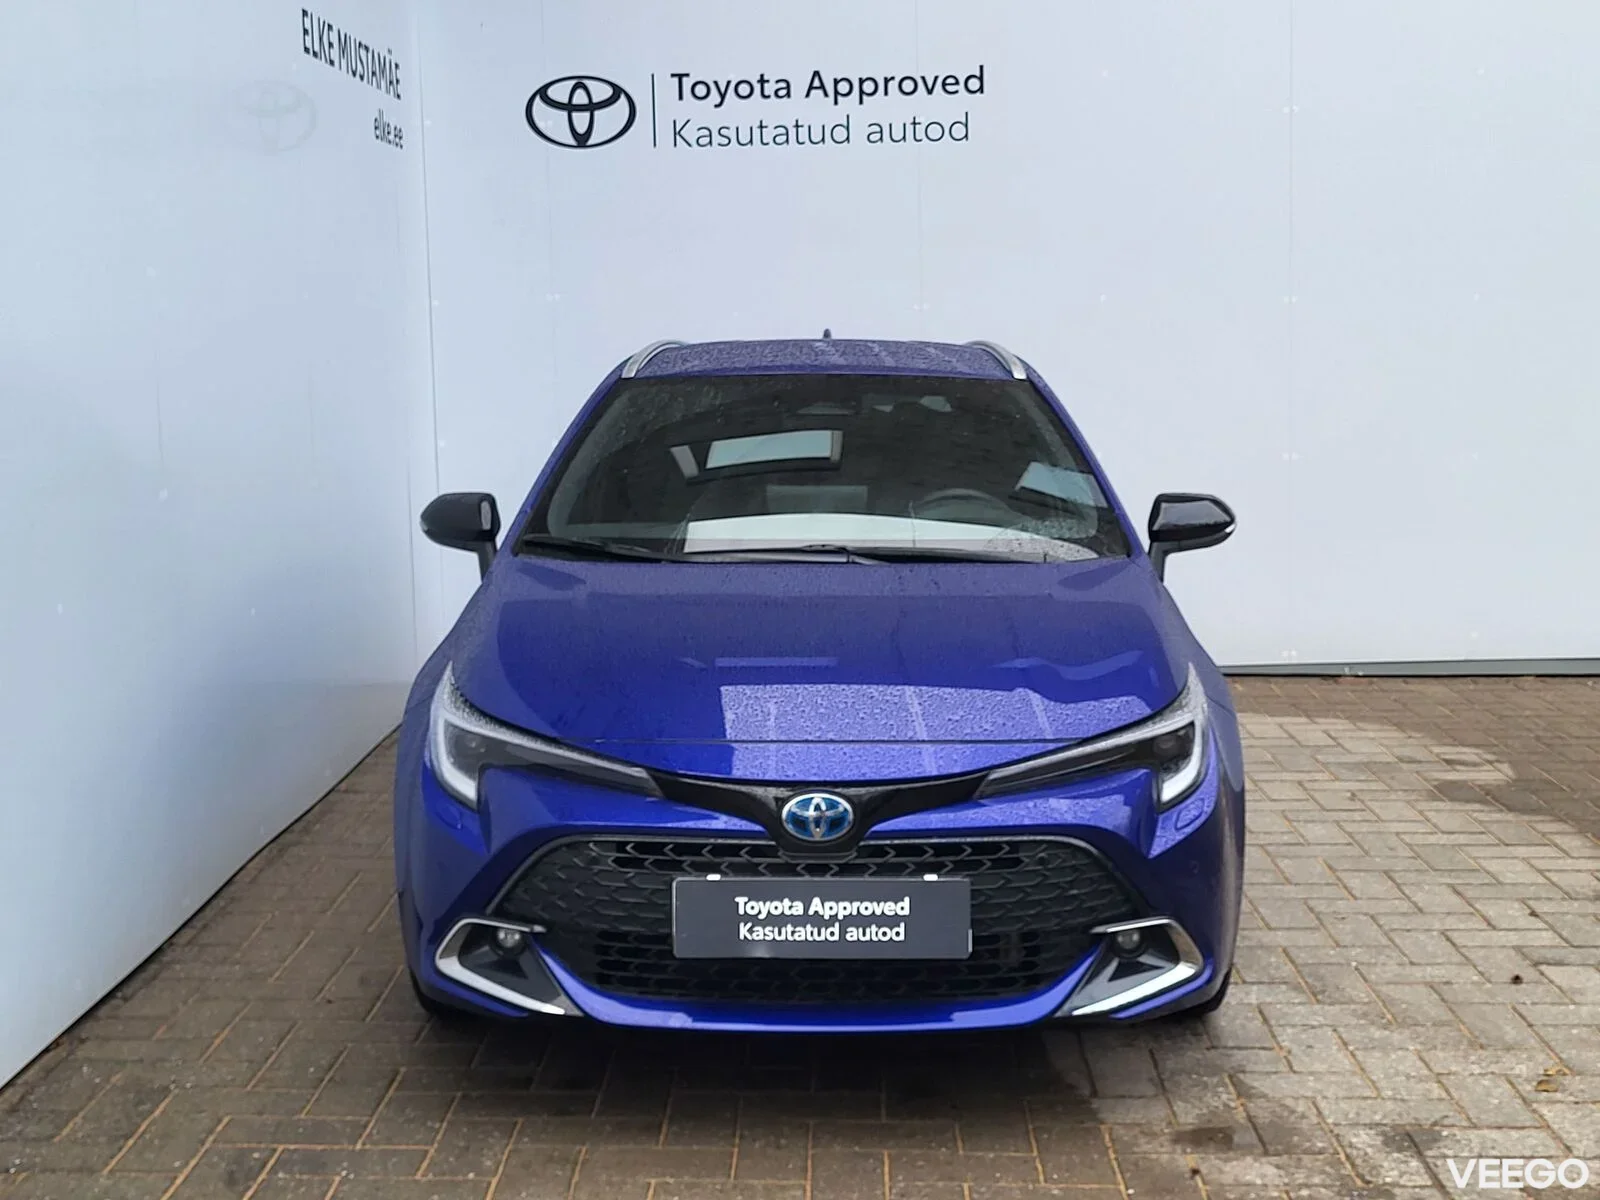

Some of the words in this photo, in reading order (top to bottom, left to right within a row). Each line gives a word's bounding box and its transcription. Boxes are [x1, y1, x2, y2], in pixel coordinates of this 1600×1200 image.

[301, 8, 335, 68] ELKE
[337, 27, 401, 101] MUSTAMÄE
[670, 71, 793, 109] Toyota
[804, 64, 985, 106] Approved
[373, 108, 403, 150] elke.ee
[672, 112, 852, 149] Kasutatud
[866, 111, 970, 144] autod
[734, 896, 804, 920] Toyota
[807, 895, 911, 921] Approved
[738, 921, 840, 942] Kasutatud
[845, 921, 905, 942] autod
